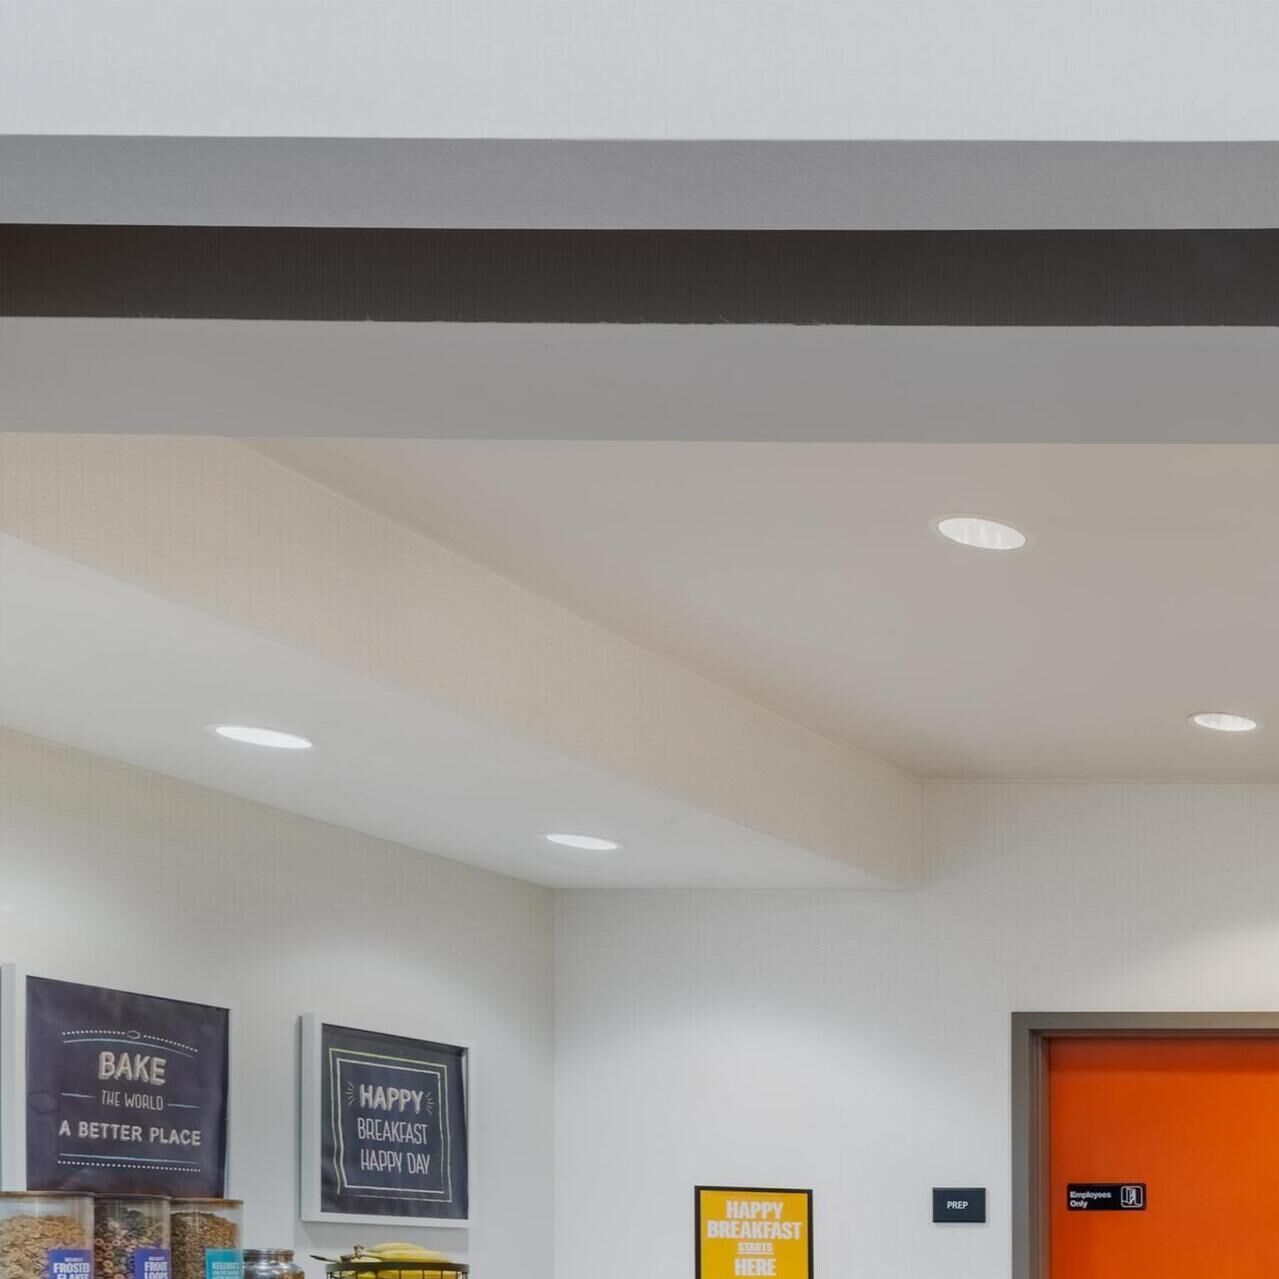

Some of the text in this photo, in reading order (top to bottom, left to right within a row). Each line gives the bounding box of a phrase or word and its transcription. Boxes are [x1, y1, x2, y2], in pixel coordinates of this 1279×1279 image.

[98, 1051, 167, 1085] BAKE
[101, 1089, 164, 1111] THE WORLD
[360, 1083, 424, 1114] HAPPY
[58, 1120, 201, 1146] A BETTER PLACE
[357, 1117, 428, 1144] BREAKFAST
[360, 1148, 430, 1175] HAPPY DAY
[1069, 1190, 1112, 1200] Employees
[1070, 1200, 1088, 1208] Only
[726, 1200, 784, 1219] HAPPY
[946, 1201, 969, 1210] PREP
[707, 1220, 802, 1240] BREAKFAST
[737, 1242, 774, 1254] STARTS
[53, 1262, 90, 1273] FROSTED
[734, 1258, 776, 1276] HERE
